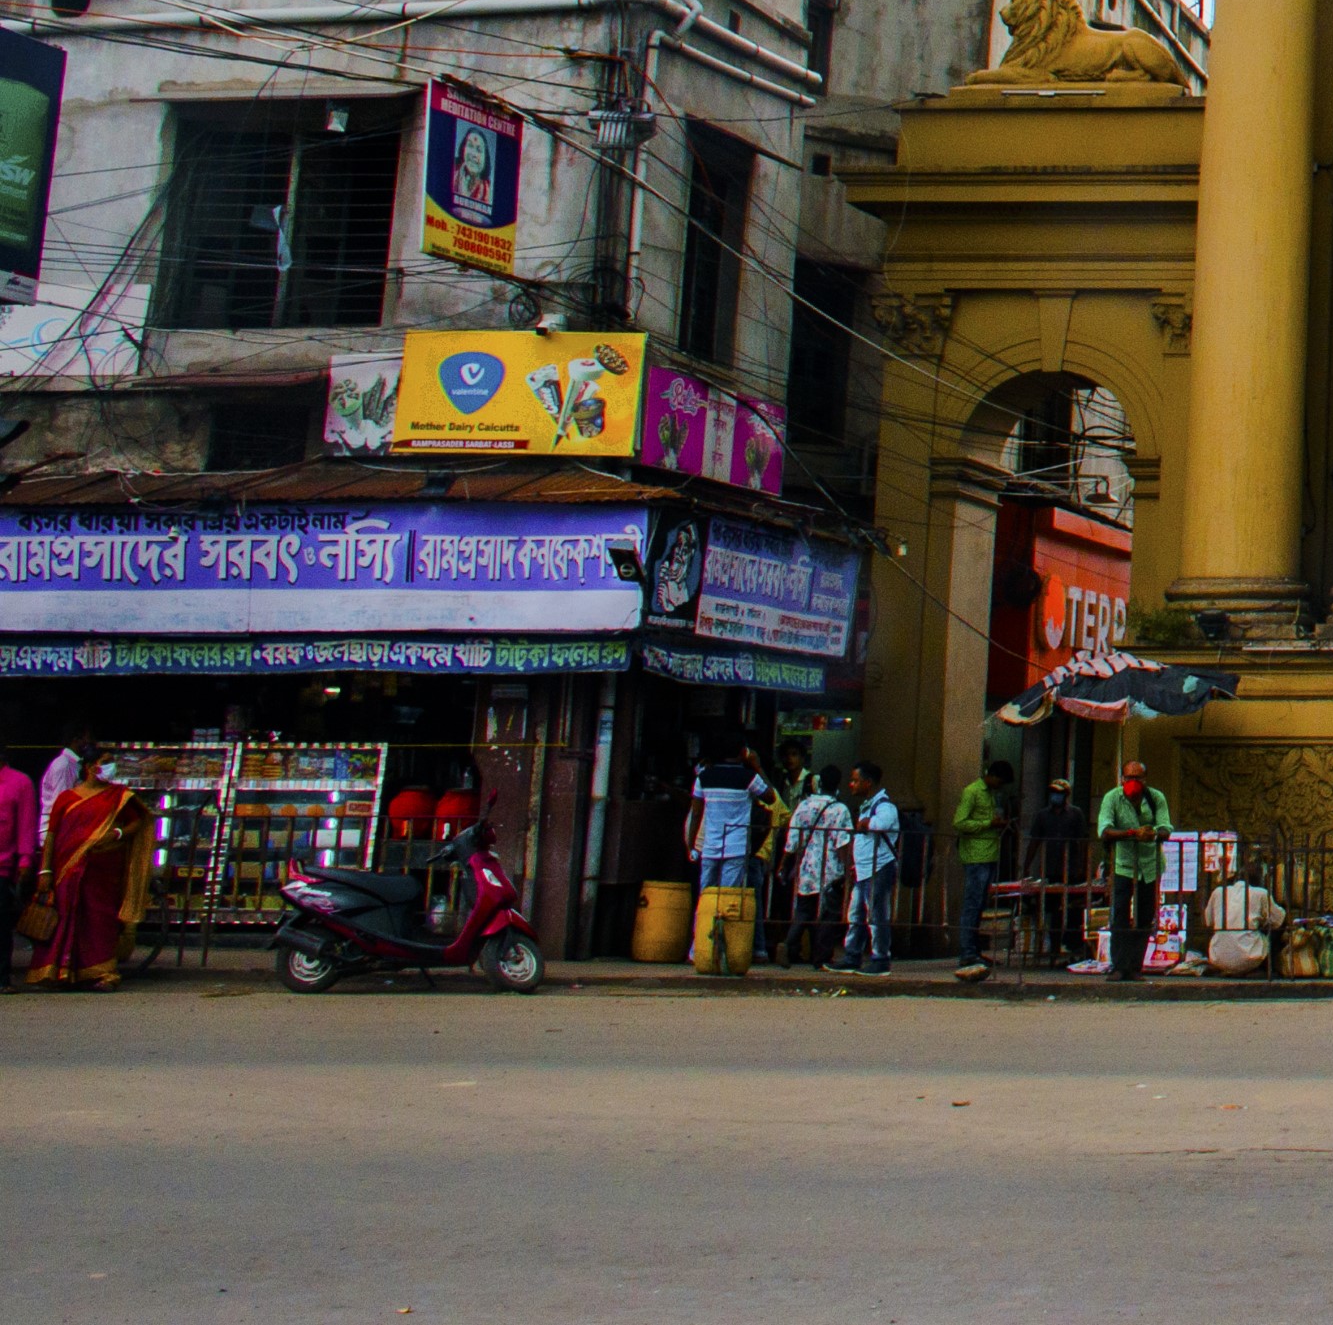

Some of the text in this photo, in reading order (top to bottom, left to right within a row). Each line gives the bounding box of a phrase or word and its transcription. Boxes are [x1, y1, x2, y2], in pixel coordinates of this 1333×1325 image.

[451, 388, 490, 397] valentine
[410, 422, 520, 433] Mother Dairy Calcutta
[200, 534, 301, 584] সরবৎ
